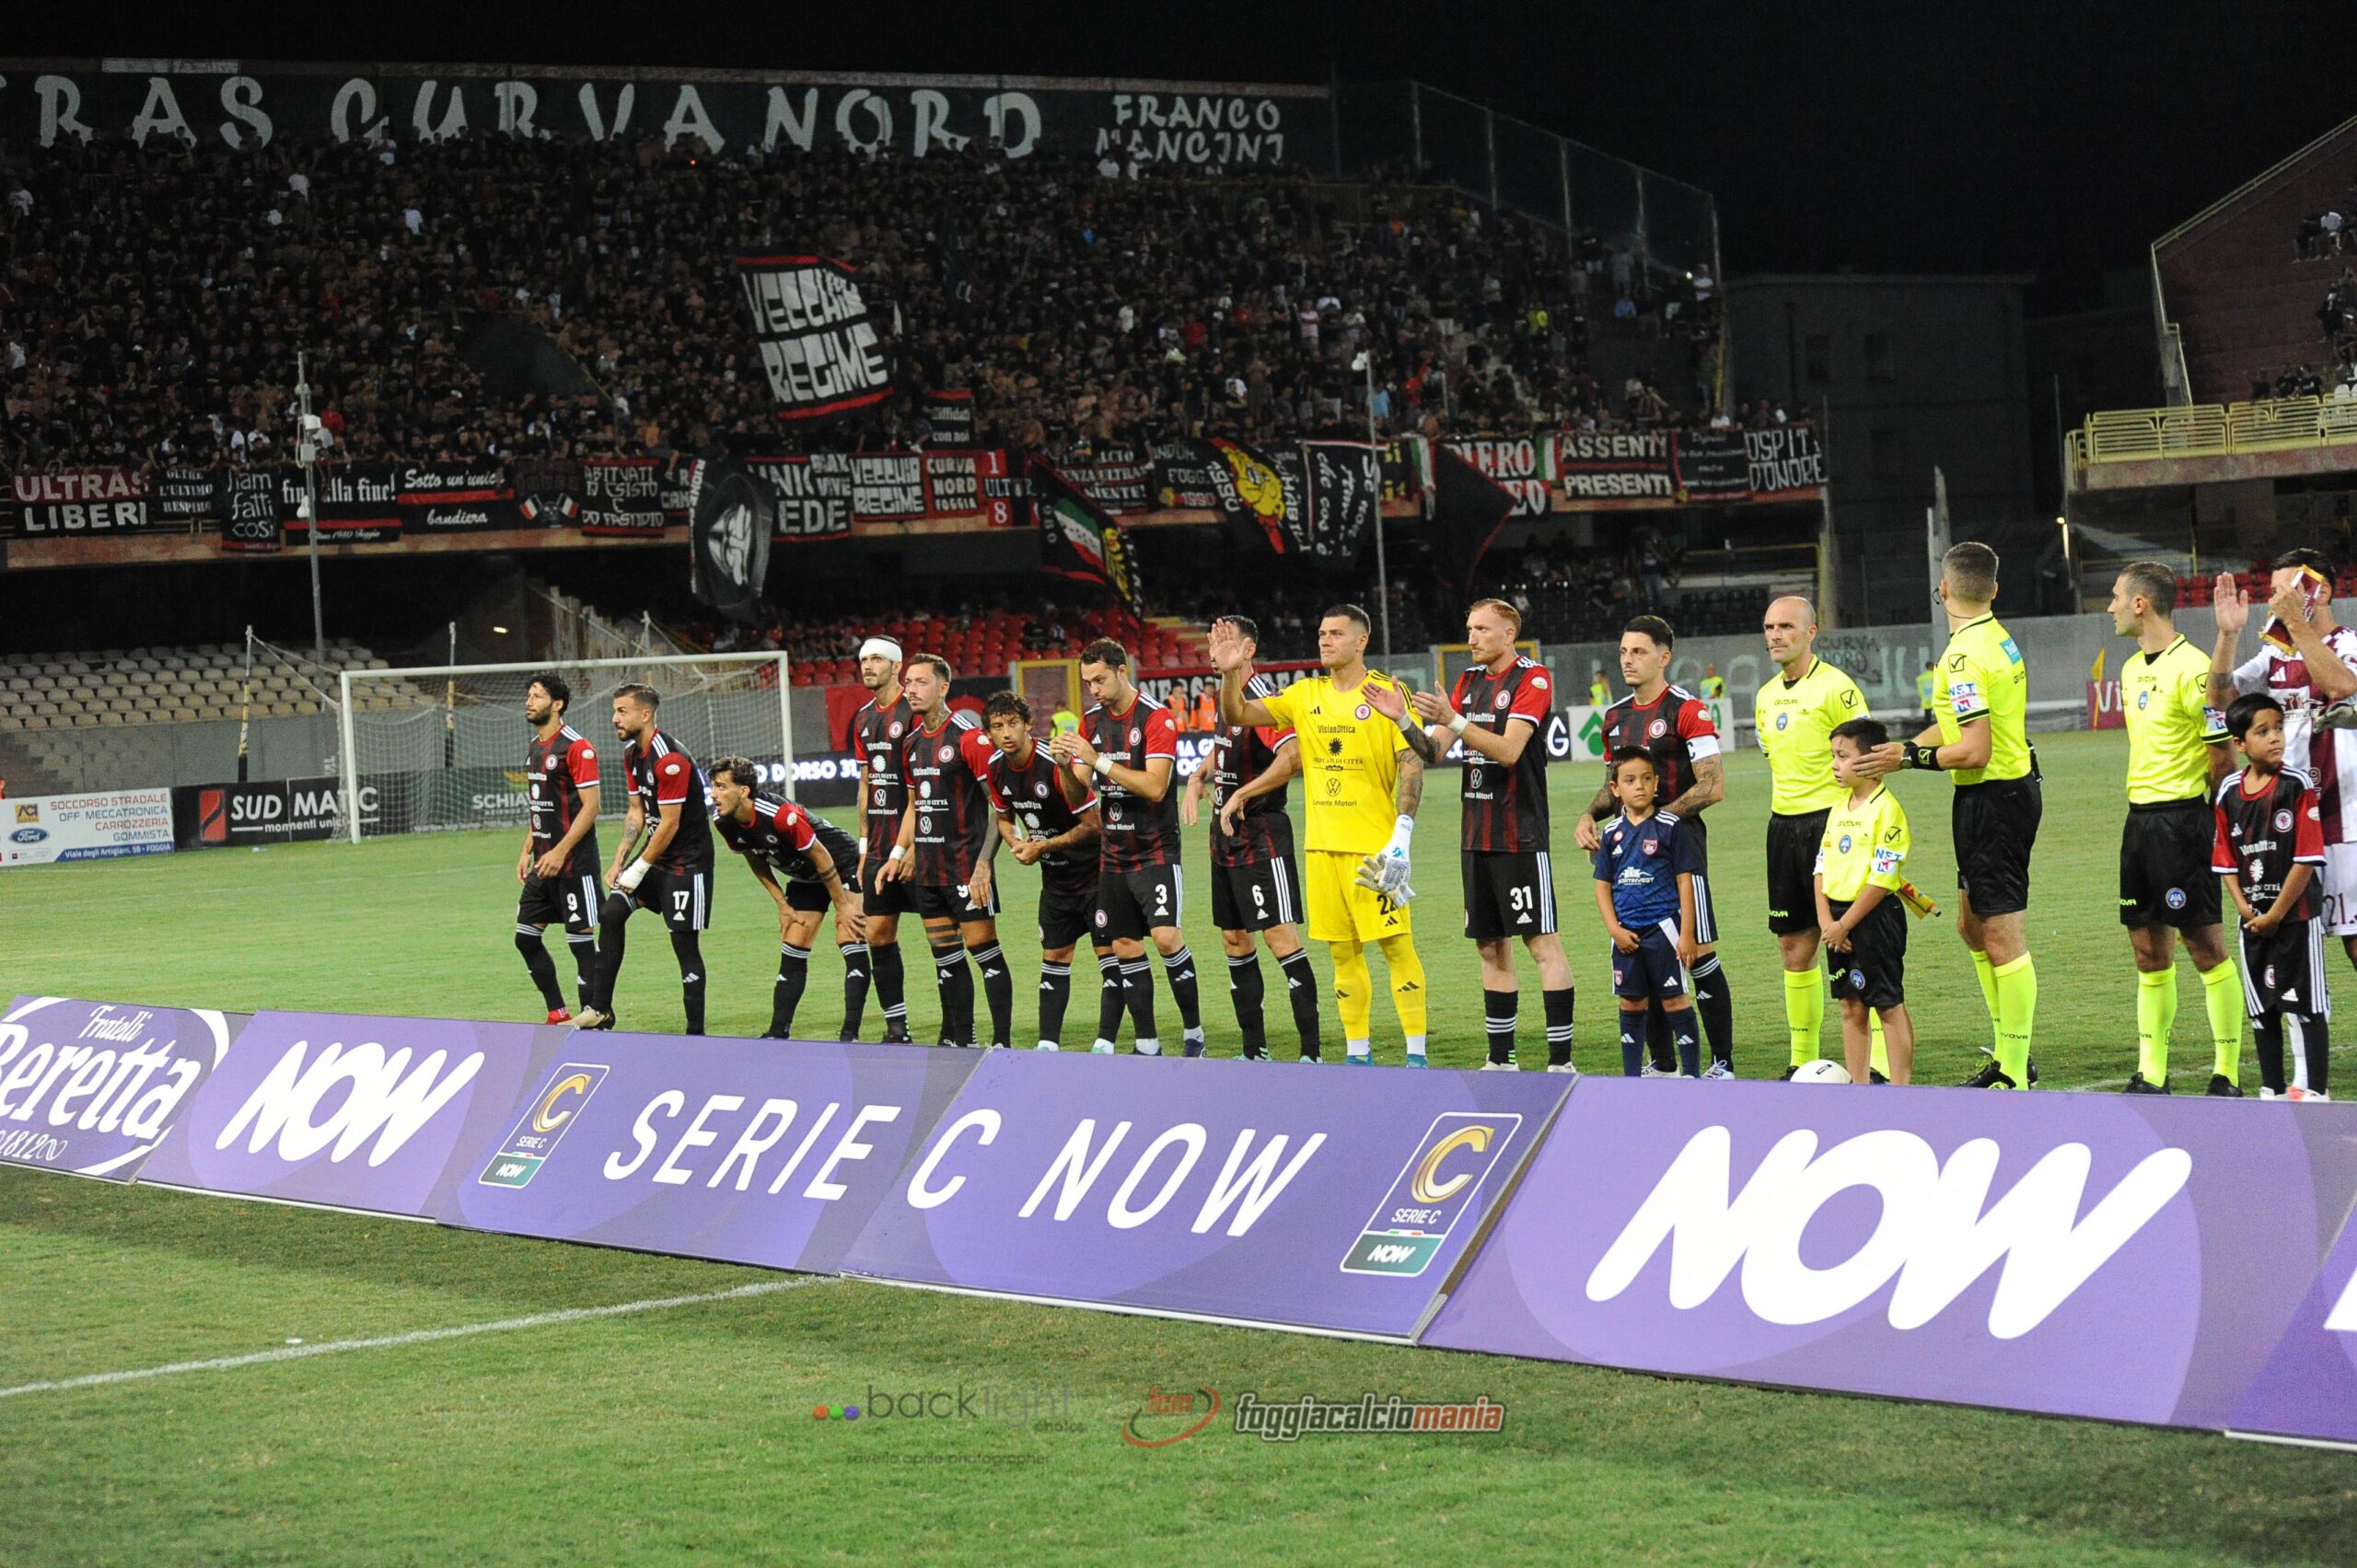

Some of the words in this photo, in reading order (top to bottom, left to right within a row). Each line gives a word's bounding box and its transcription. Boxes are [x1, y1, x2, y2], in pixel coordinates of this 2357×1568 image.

[0, 75, 273, 149] RAS
[331, 77, 726, 154] CURVA
[764, 87, 1042, 159] NORD
[1112, 94, 1281, 131] FRANCO
[1562, 434, 1667, 459] ASSENTI
[926, 458, 977, 474] CURVA
[14, 471, 149, 502] ULTRAS
[357, 472, 397, 503] fine!
[404, 467, 441, 489] Sotto
[933, 477, 978, 495] NORD
[1567, 473, 1672, 498] PRESENTI
[25, 502, 147, 531] LIBERI
[17, 804, 39, 818] ACI
[51, 797, 109, 810] SOCCORSO
[111, 794, 167, 807] STRADALE
[86, 806, 168, 819] MECCATRONICA
[231, 795, 283, 820] SUD
[294, 786, 379, 818] MATC
[96, 818, 168, 831] CARROZZERIA
[264, 819, 317, 833] momenti
[17, 830, 41, 842] Ford
[113, 830, 169, 842] GOMMISTA
[64, 850, 82, 858] Viale
[83, 849, 100, 859] degli
[146, 843, 171, 852] FOGGIA
[566, 892, 578, 911] 9
[672, 890, 690, 910] 17
[1155, 884, 1167, 905] 3
[1252, 884, 1264, 907] 6
[1510, 886, 1533, 911] 31
[2326, 892, 2346, 924] 21
[77, 1005, 154, 1043] Fratelli
[215, 1040, 485, 1167] NOW
[532, 1074, 593, 1132] C
[516, 1135, 540, 1149] SERIE
[539, 1137, 547, 1149] C
[495, 1163, 527, 1179] NOW
[602, 1089, 901, 1201] SERIE
[907, 1109, 1002, 1209] C
[1017, 1118, 1328, 1237] NOW
[1411, 1125, 1495, 1203] C
[1391, 1208, 1432, 1225] SERIE
[1428, 1210, 1442, 1225] C
[1585, 1125, 2193, 1340] NOW
[1367, 1245, 1416, 1263] NOW
